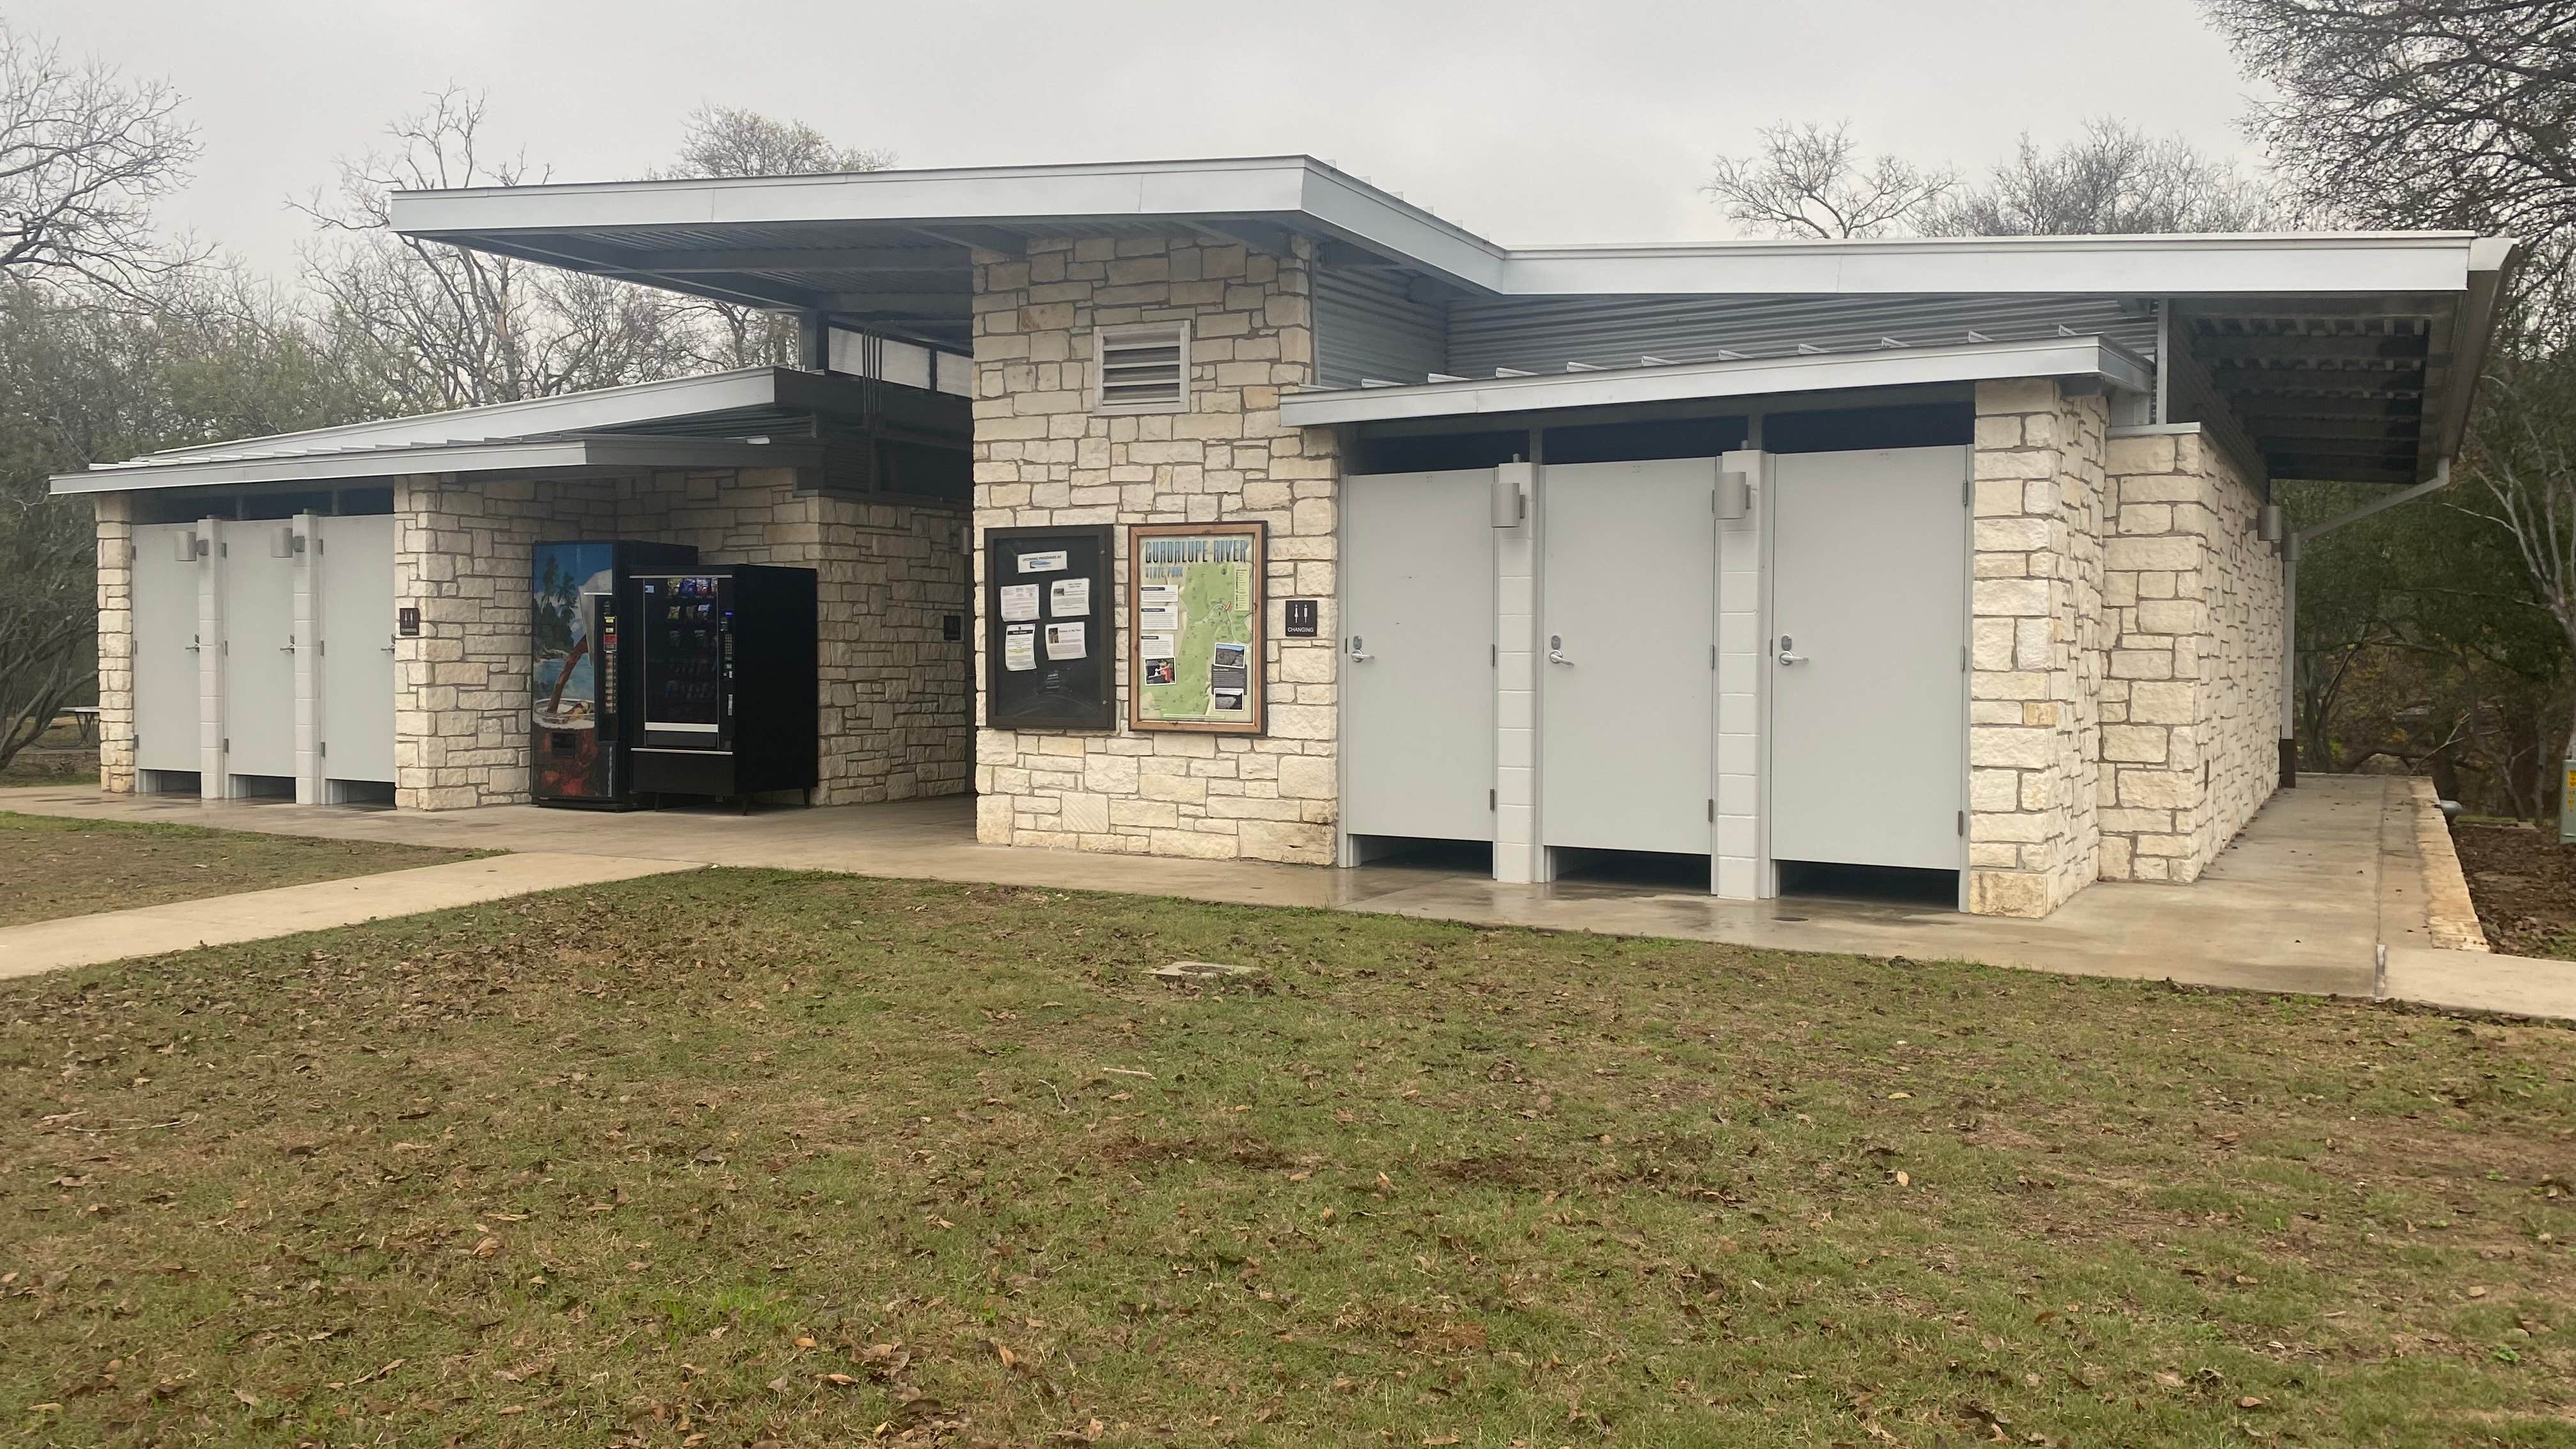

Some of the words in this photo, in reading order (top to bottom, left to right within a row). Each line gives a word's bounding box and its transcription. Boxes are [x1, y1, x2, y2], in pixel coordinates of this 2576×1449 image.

[1146, 540, 1208, 564] GUADALUPE
[1213, 540, 1246, 564] RIVER
[1145, 567, 1165, 579] STATE
[1167, 567, 1183, 578] PARK
